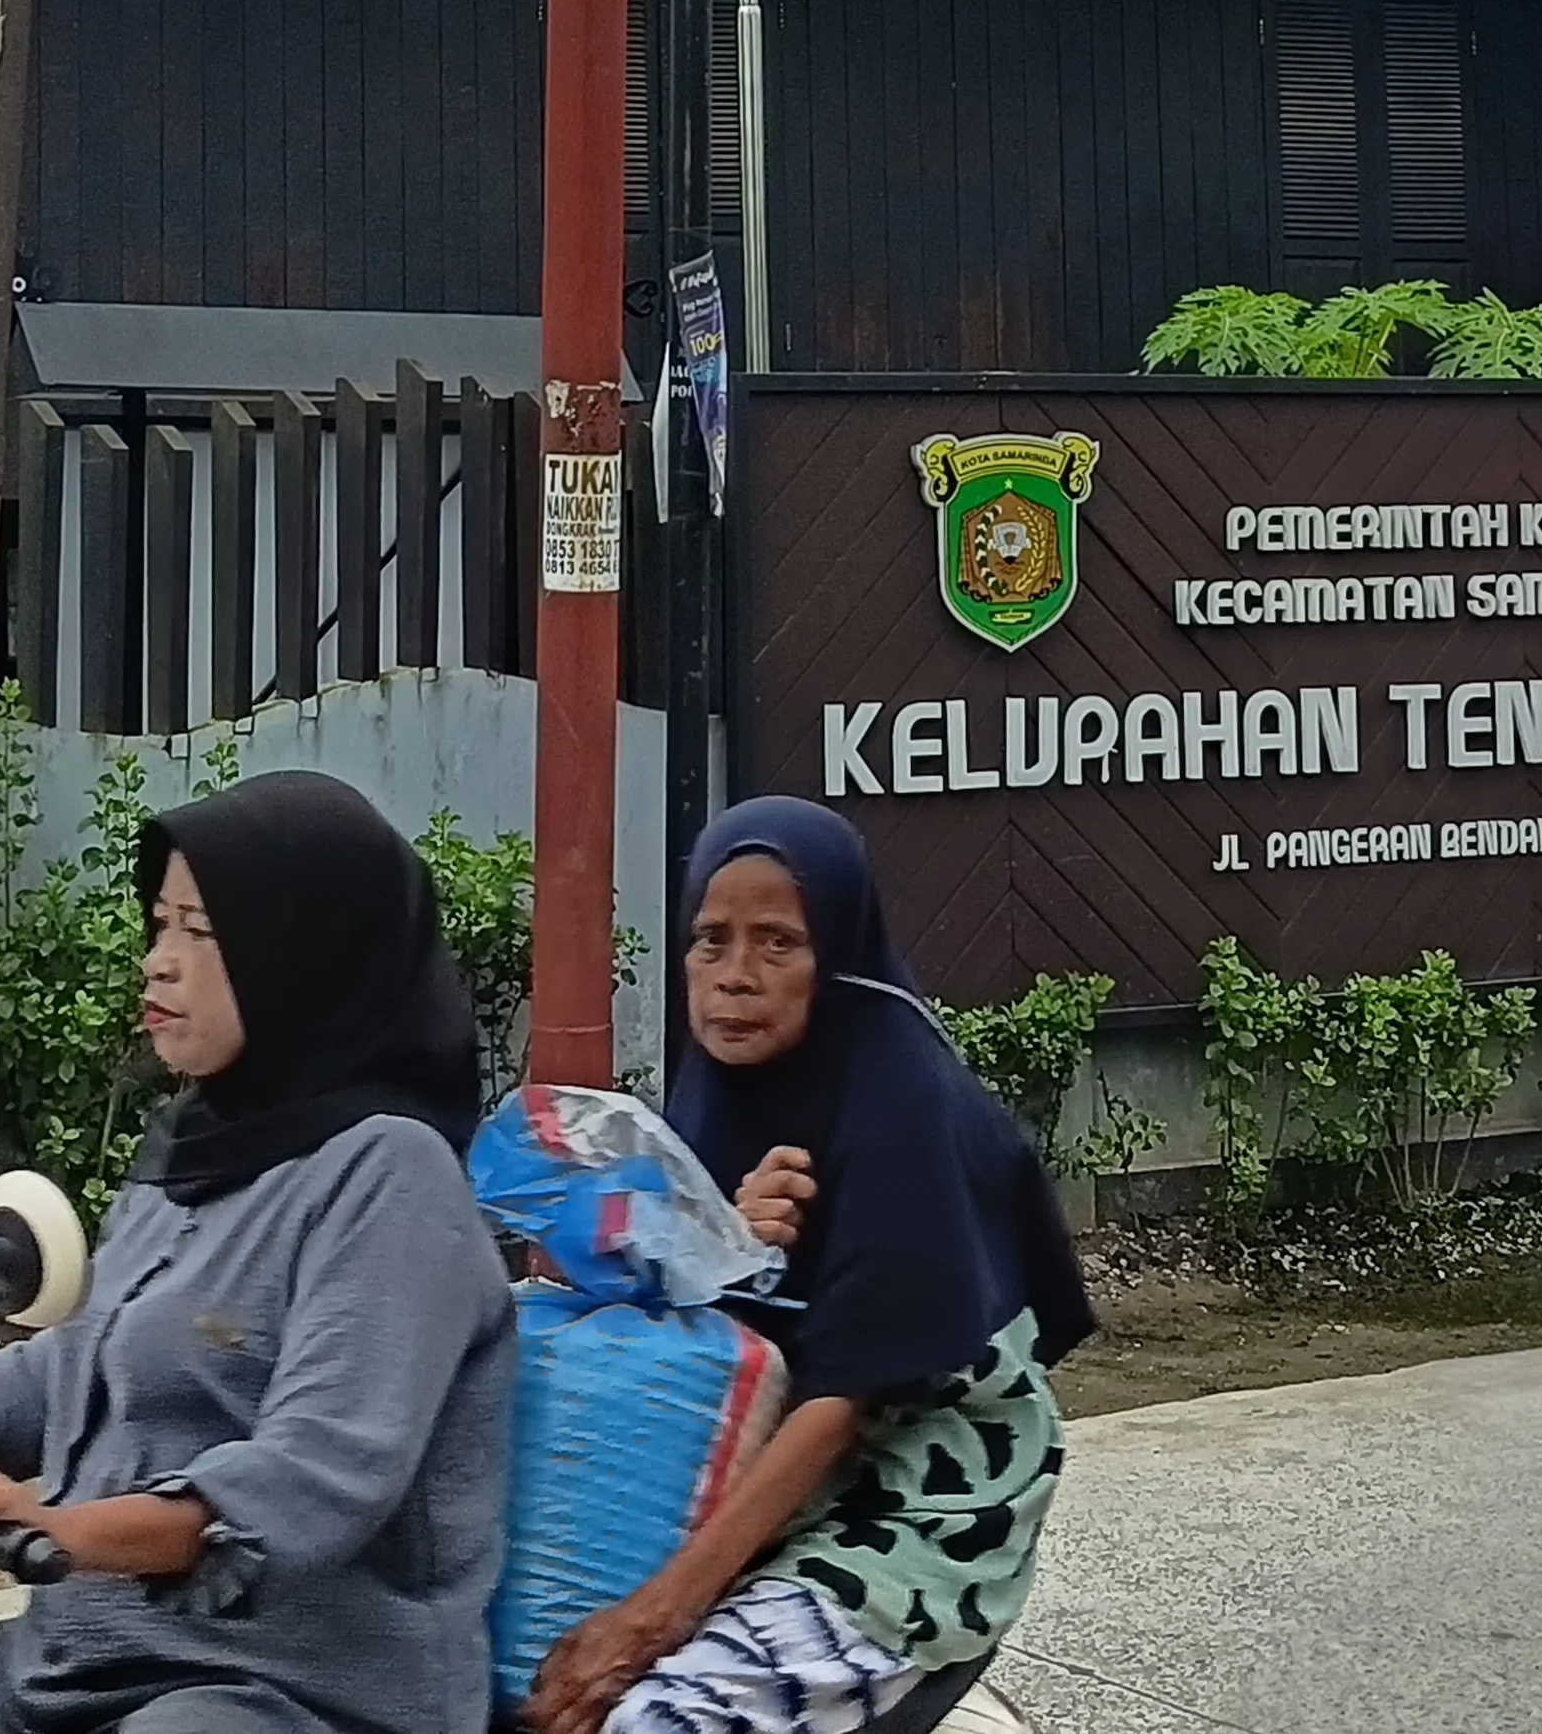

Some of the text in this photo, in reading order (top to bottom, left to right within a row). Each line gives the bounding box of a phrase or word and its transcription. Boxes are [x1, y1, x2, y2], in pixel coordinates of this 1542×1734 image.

[961, 450, 1057, 470] KOTA SAMARINDA
[545, 538, 576, 560] 0853
[1226, 504, 1509, 551] PEMERINTAH
[545, 558, 576, 575] 0813
[1175, 574, 1456, 626] KECAMATAN
[823, 686, 1359, 797] KELURAHAN
[1212, 834, 1251, 872] JL
[1266, 823, 1432, 869] PANGERAN
